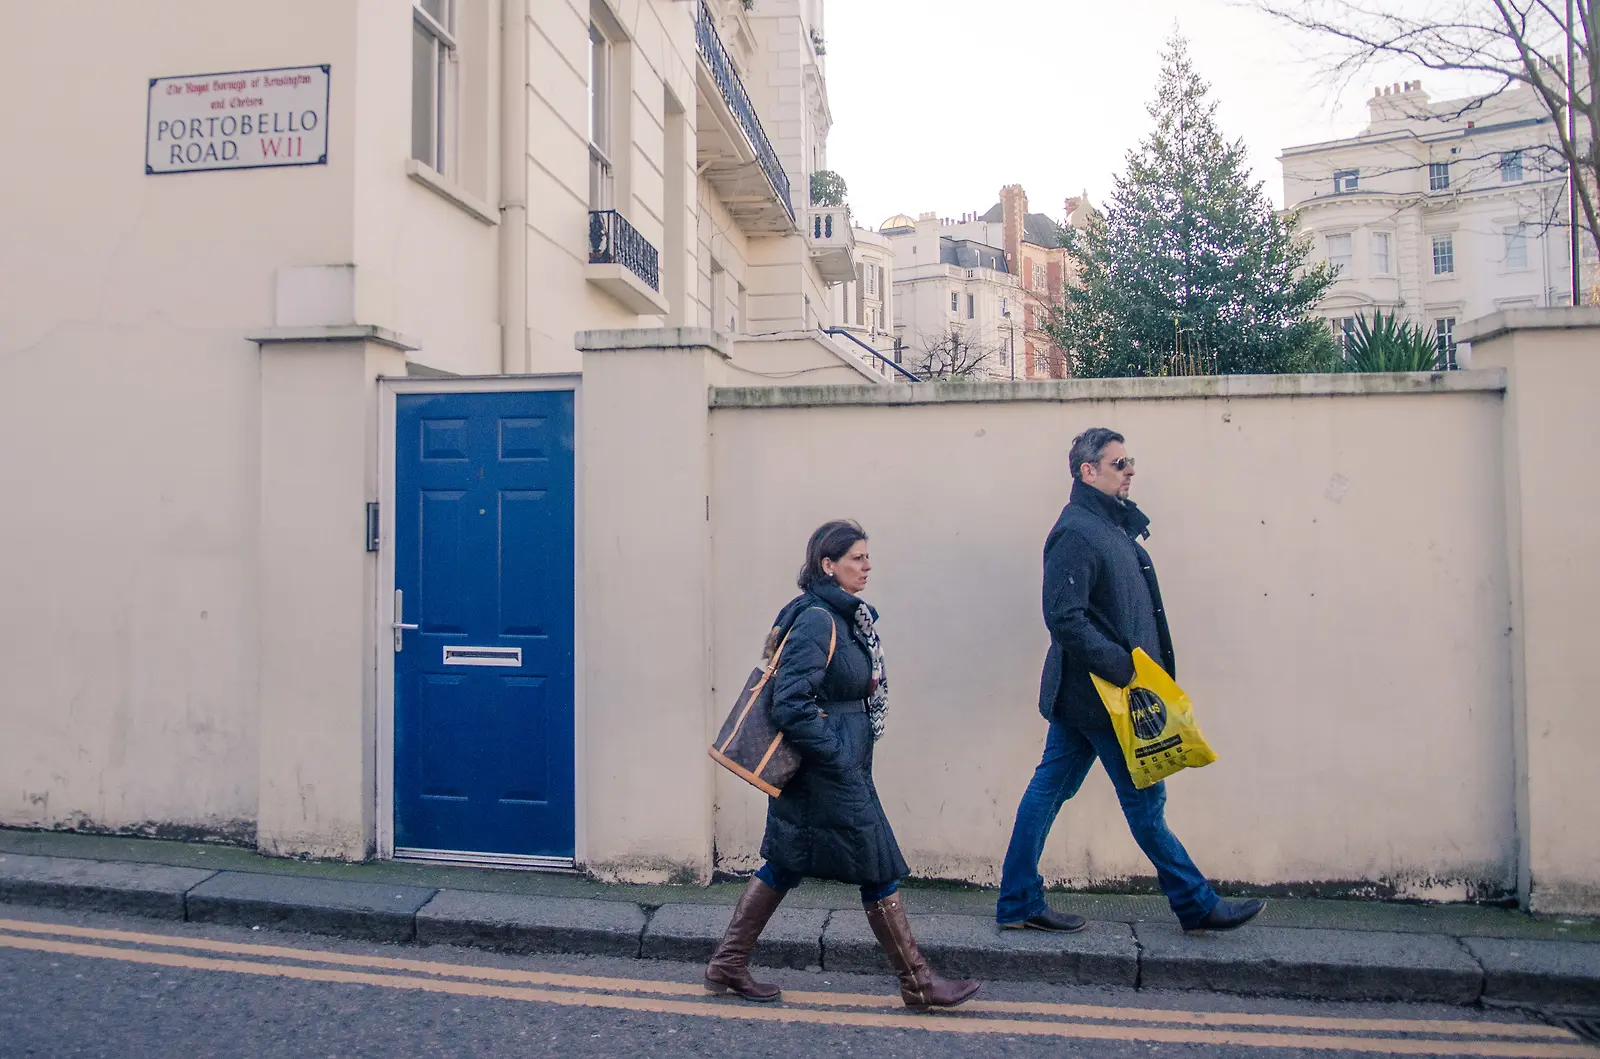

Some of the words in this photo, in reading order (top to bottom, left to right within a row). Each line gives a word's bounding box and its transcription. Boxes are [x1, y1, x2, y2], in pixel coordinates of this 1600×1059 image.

[167, 83, 182, 95] The
[186, 82, 209, 95] Royal
[213, 79, 247, 91] Borough
[251, 77, 260, 88] of
[263, 74, 312, 88] Kensington
[210, 99, 225, 109] and
[229, 96, 264, 108] Chelsea
[157, 109, 318, 141] PORTOBELLO
